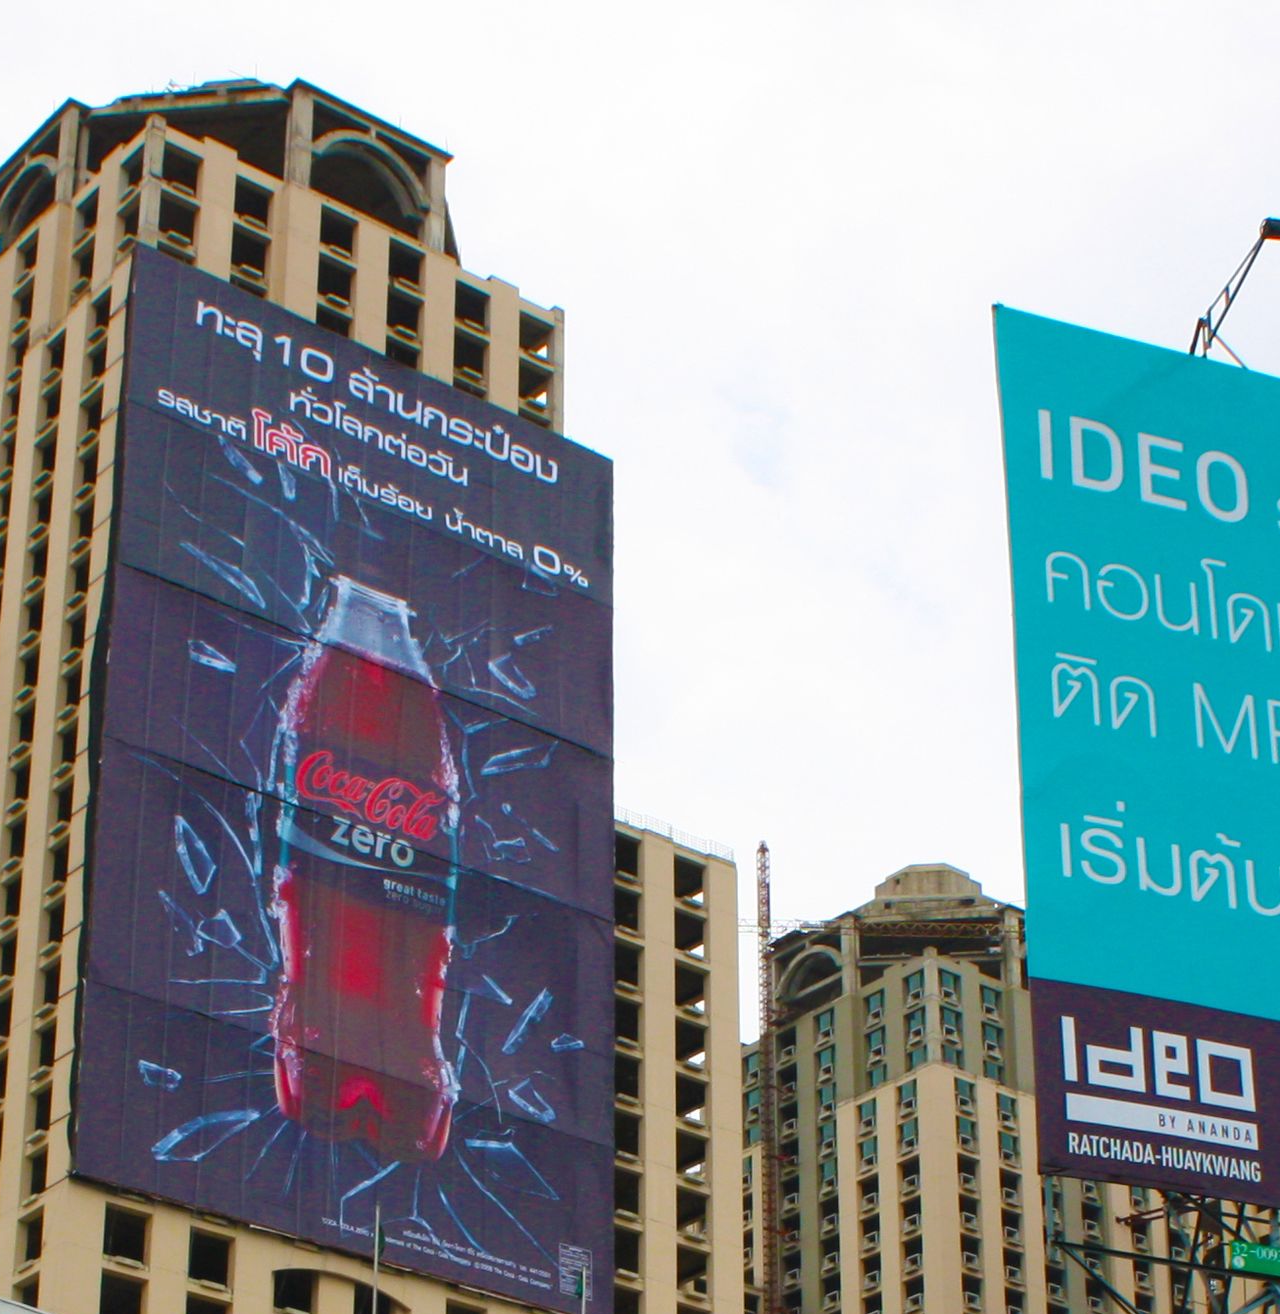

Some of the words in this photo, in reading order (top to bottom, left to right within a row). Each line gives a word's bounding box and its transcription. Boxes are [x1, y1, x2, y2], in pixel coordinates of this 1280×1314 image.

[195, 300, 263, 362] ทะลุ
[274, 336, 334, 383] 10
[348, 367, 558, 484] ล้านกระป๋อง
[289, 386, 468, 486] ทั่วโลกต่อวัน
[157, 388, 247, 440] รสชาติ
[252, 408, 332, 479] โค้ก
[338, 462, 432, 522] เต็มร้อย
[445, 508, 523, 560] น้ำตาล
[533, 542, 589, 588] 0%
[1037, 409, 1250, 524] IDEO
[1051, 653, 1157, 739] ติด
[296, 750, 447, 840] Coca-Cola
[331, 815, 414, 867] zero
[1068, 1132, 1262, 1183] RATCHADA-HUAYKWANG
[1158, 1113, 1176, 1129] BY
[1187, 1118, 1253, 1143] ANANDA
